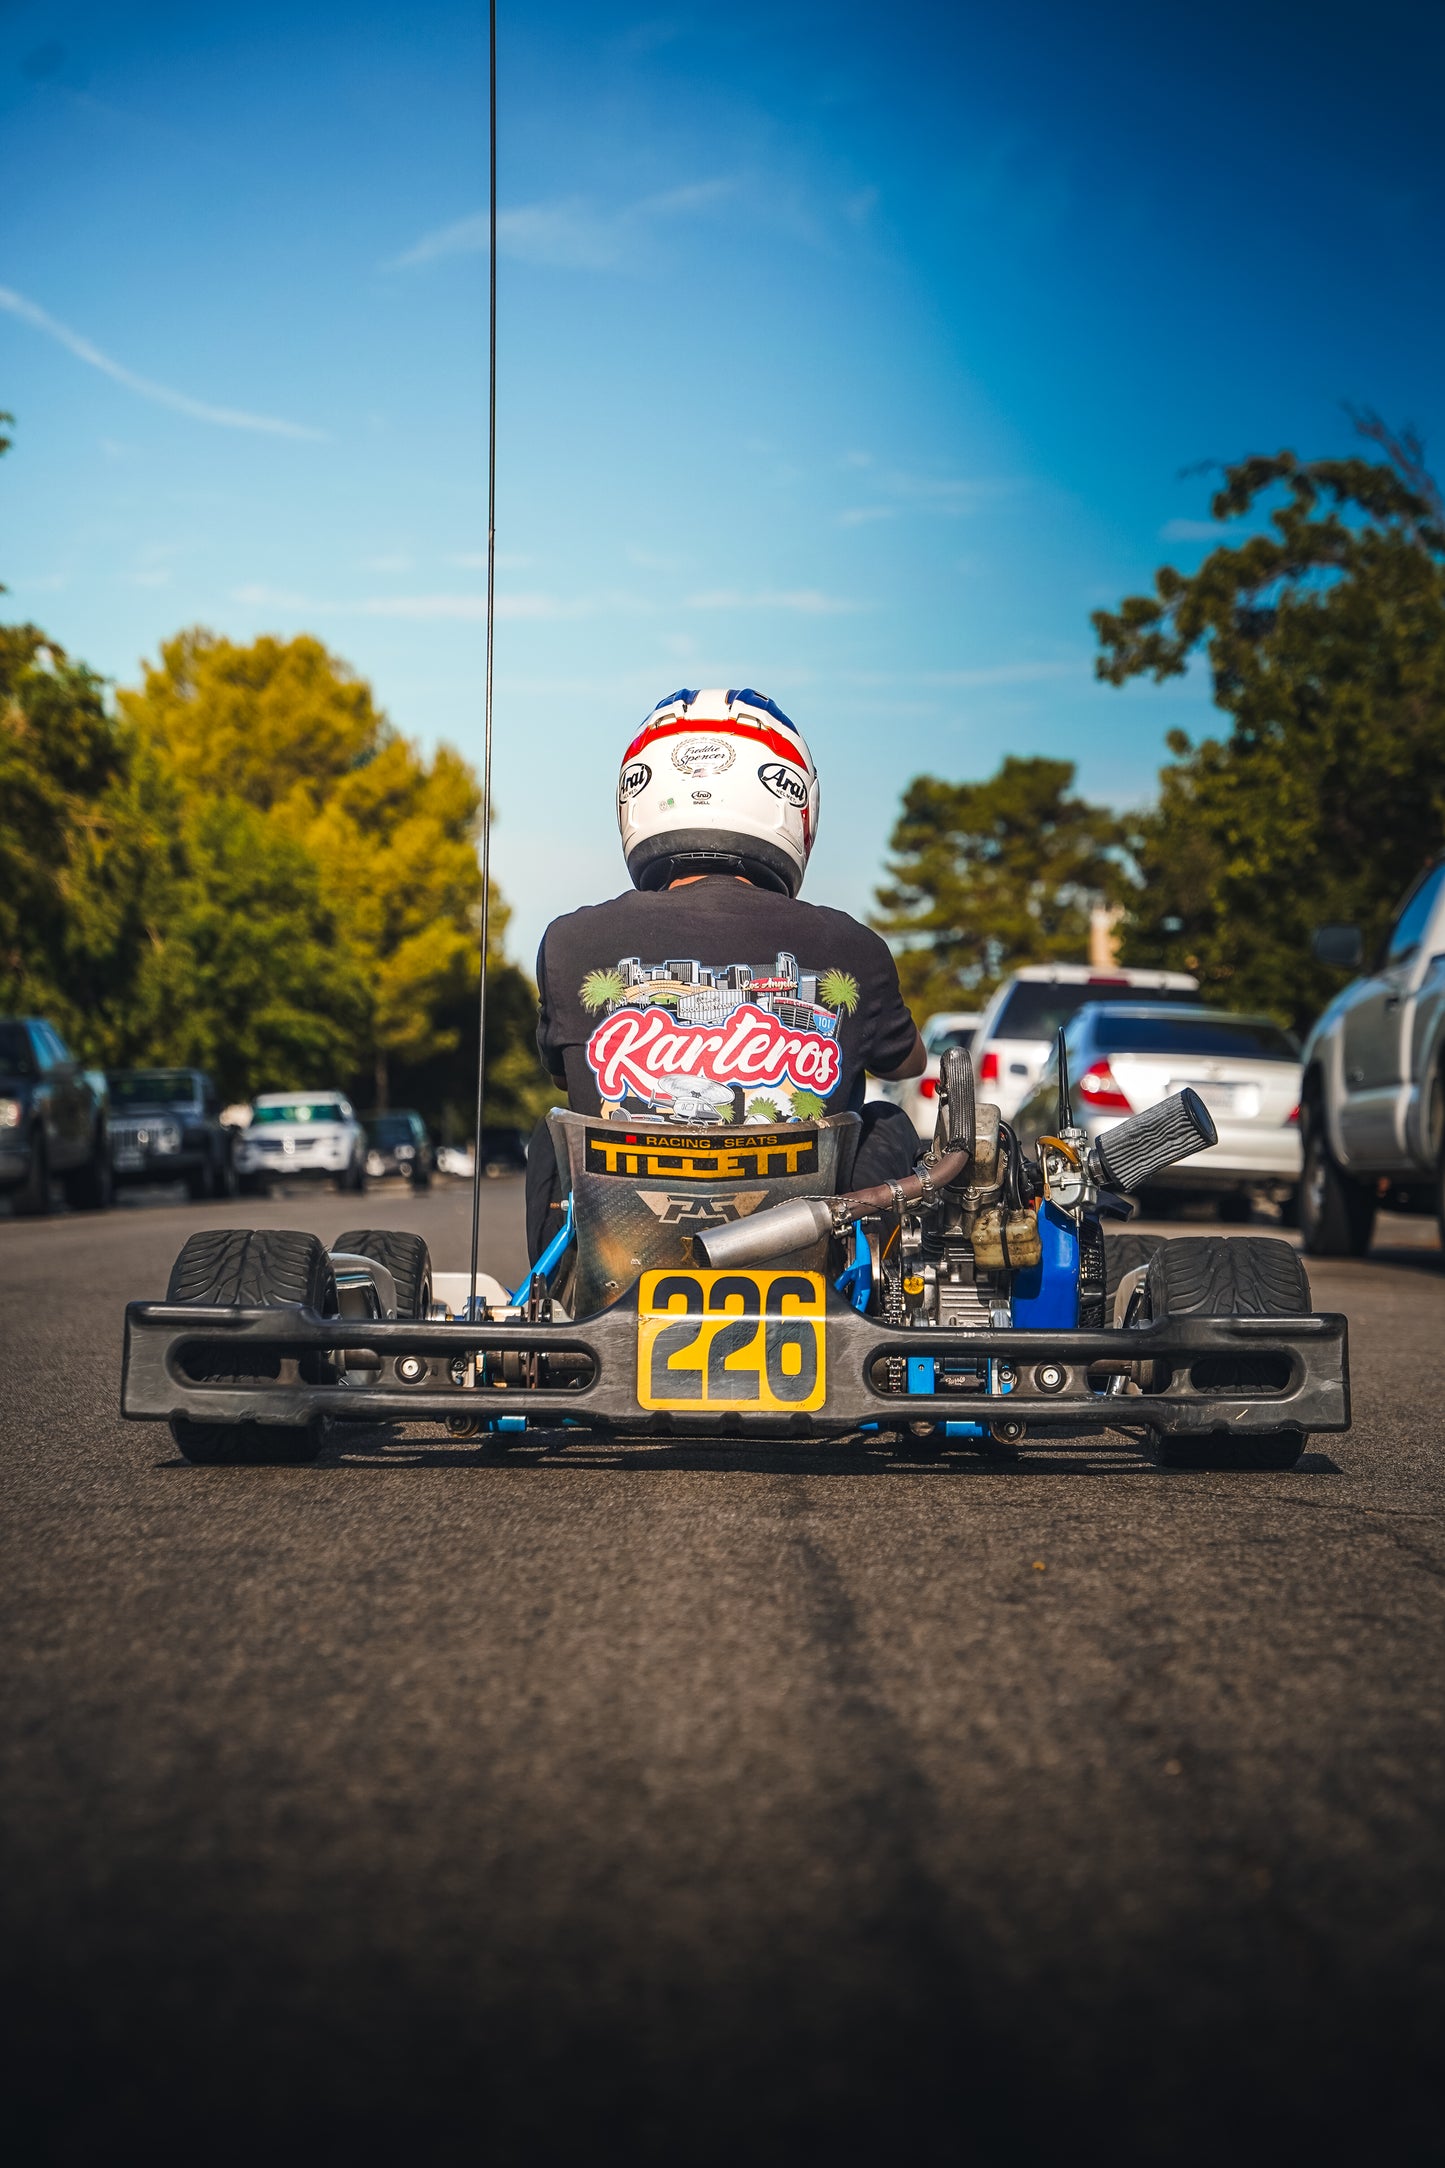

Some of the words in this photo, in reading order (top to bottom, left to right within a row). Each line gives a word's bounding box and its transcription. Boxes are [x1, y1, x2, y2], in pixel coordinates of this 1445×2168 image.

[684, 745, 720, 756] Freddie
[678, 753, 726, 766] Spencer
[762, 768, 805, 801] Arai
[739, 979, 759, 991] Los
[761, 976, 798, 991] Angeles
[818, 1016, 831, 1029] 101
[596, 1012, 834, 1092] Karteros
[646, 1136, 711, 1149] RACING
[724, 1135, 778, 1149] SEATS
[591, 1140, 813, 1178] TILLETT
[650, 1276, 818, 1403] 226
